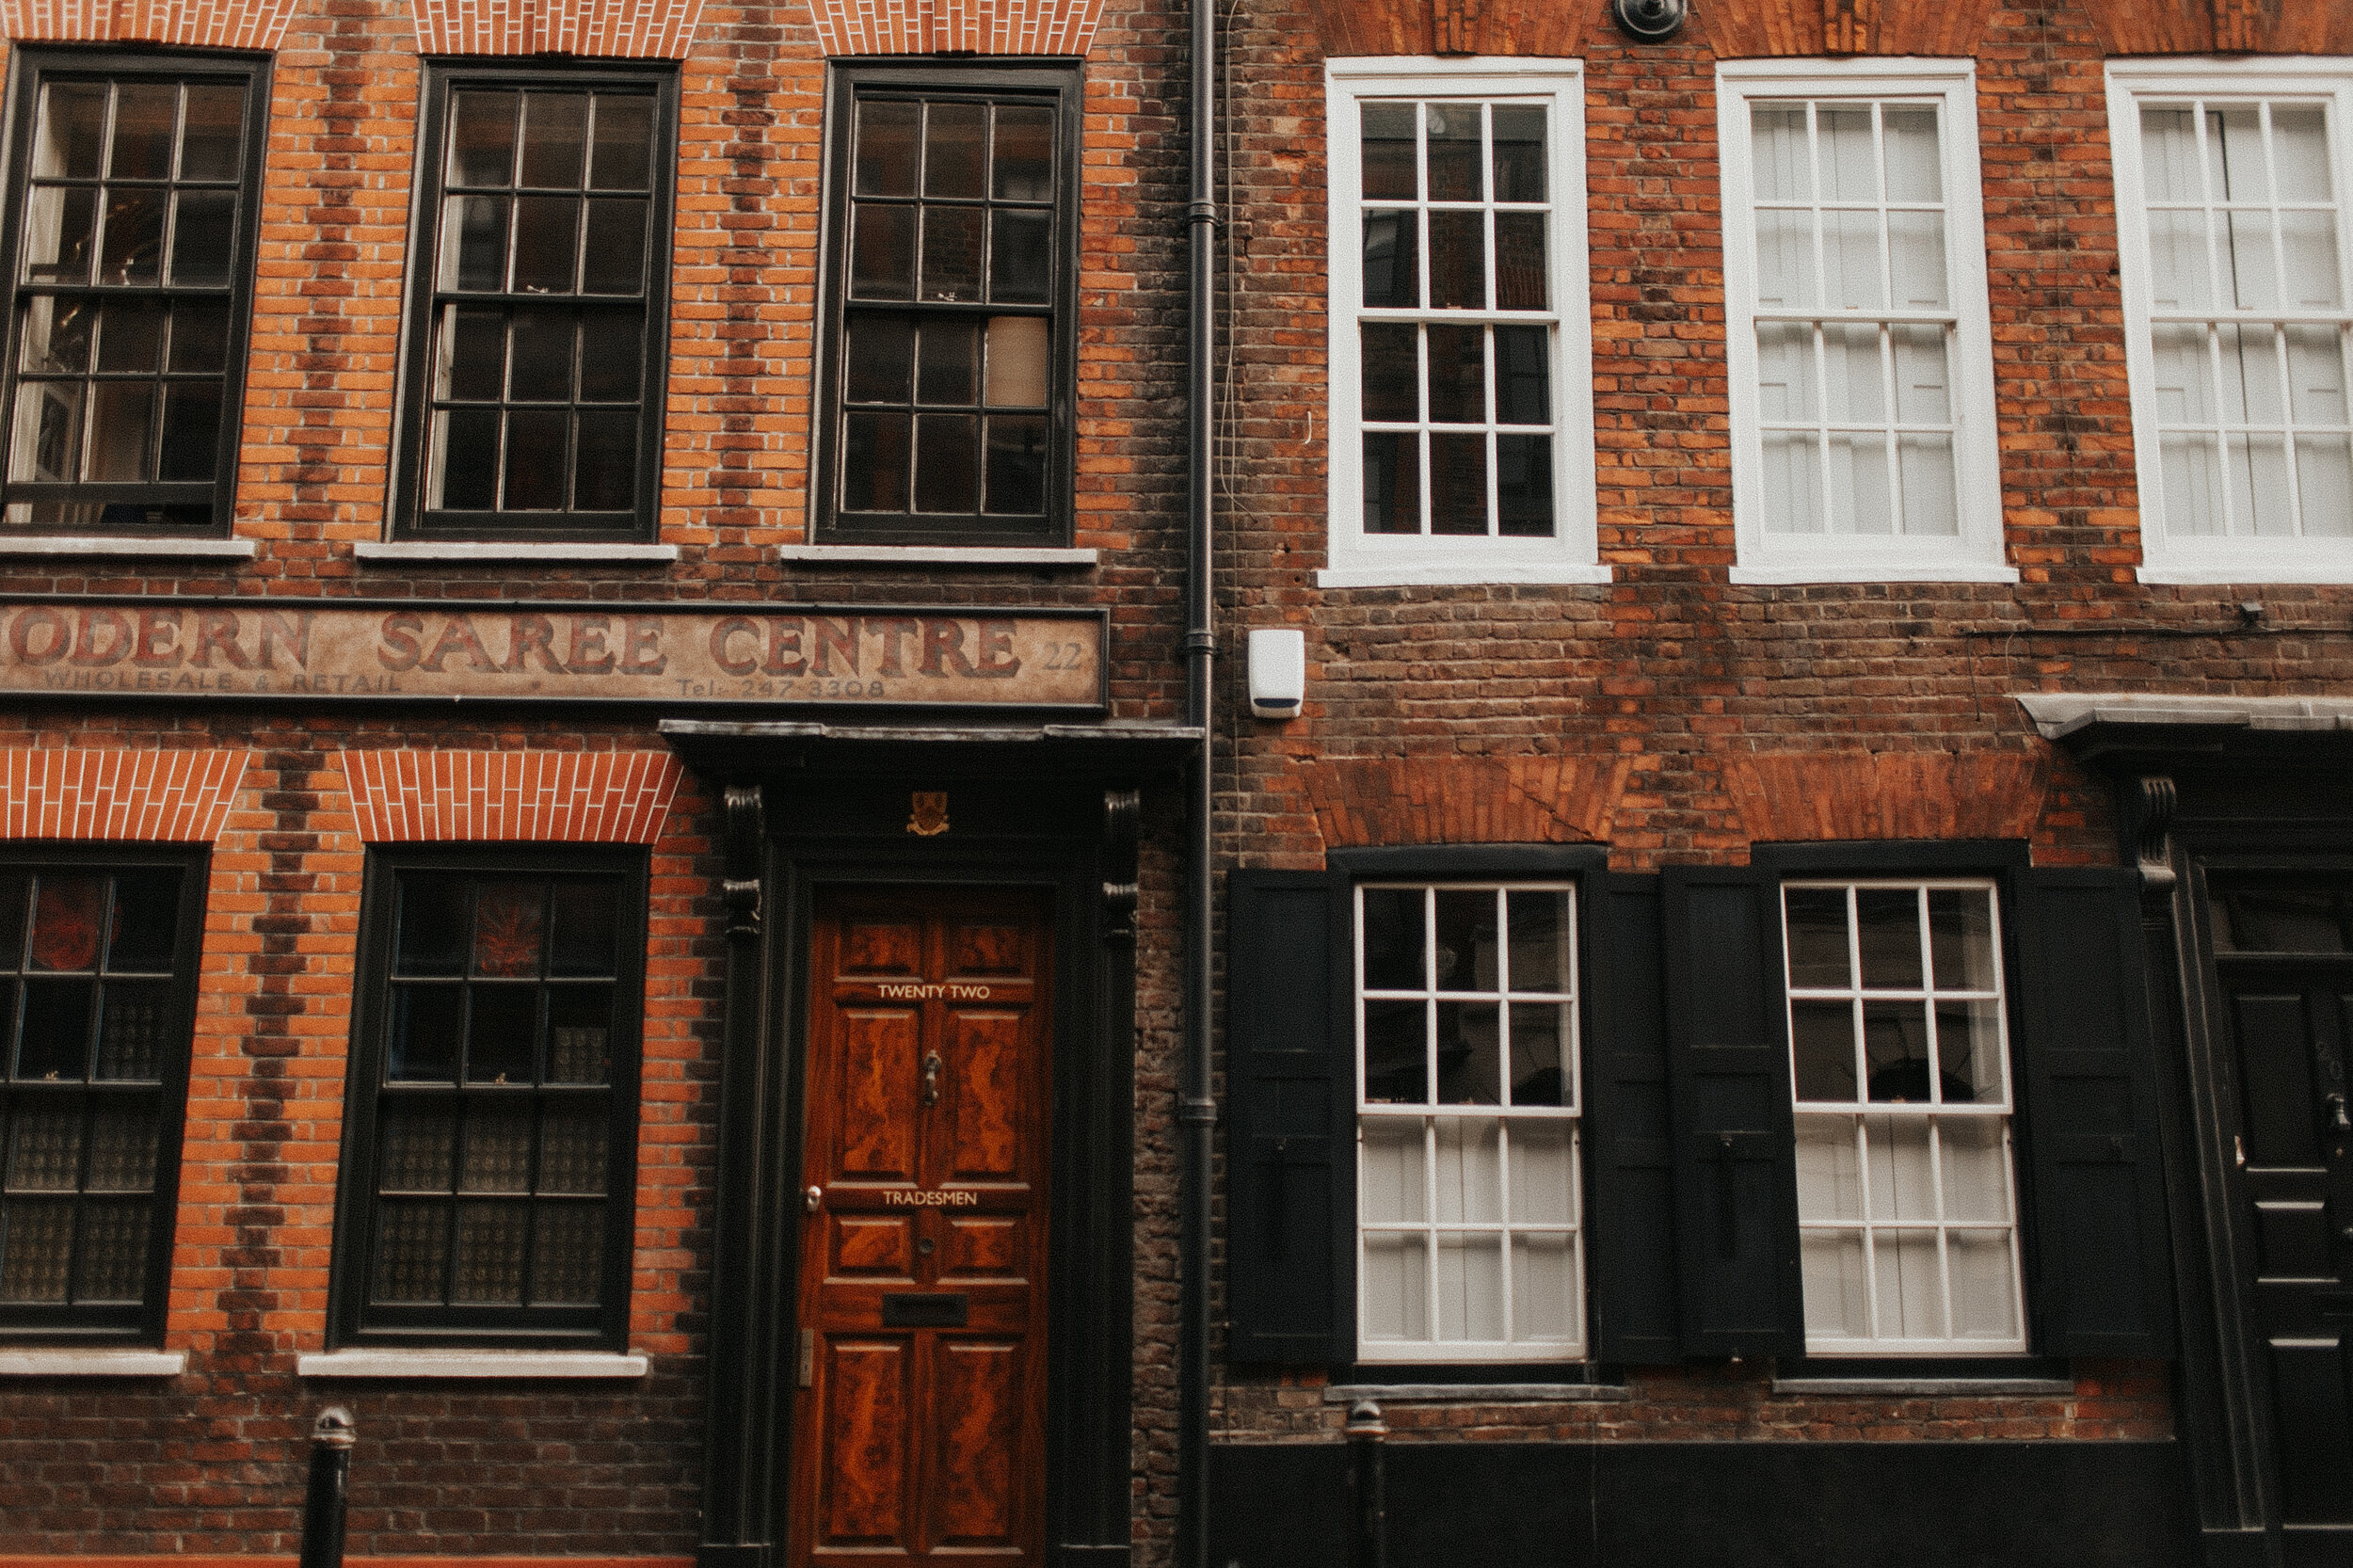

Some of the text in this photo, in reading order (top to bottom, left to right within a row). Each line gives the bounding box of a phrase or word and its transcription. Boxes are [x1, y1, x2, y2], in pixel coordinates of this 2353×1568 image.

[0, 605, 1021, 679] ODERN SAREE CENTRE
[1043, 641, 1081, 670] 22
[43, 669, 402, 693] WHOLESALE & RETAIL
[741, 680, 793, 697] 247
[808, 680, 884, 697] 3308
[878, 984, 990, 999] TWENTY TWO
[883, 1191, 977, 1206] TRADESMEN
